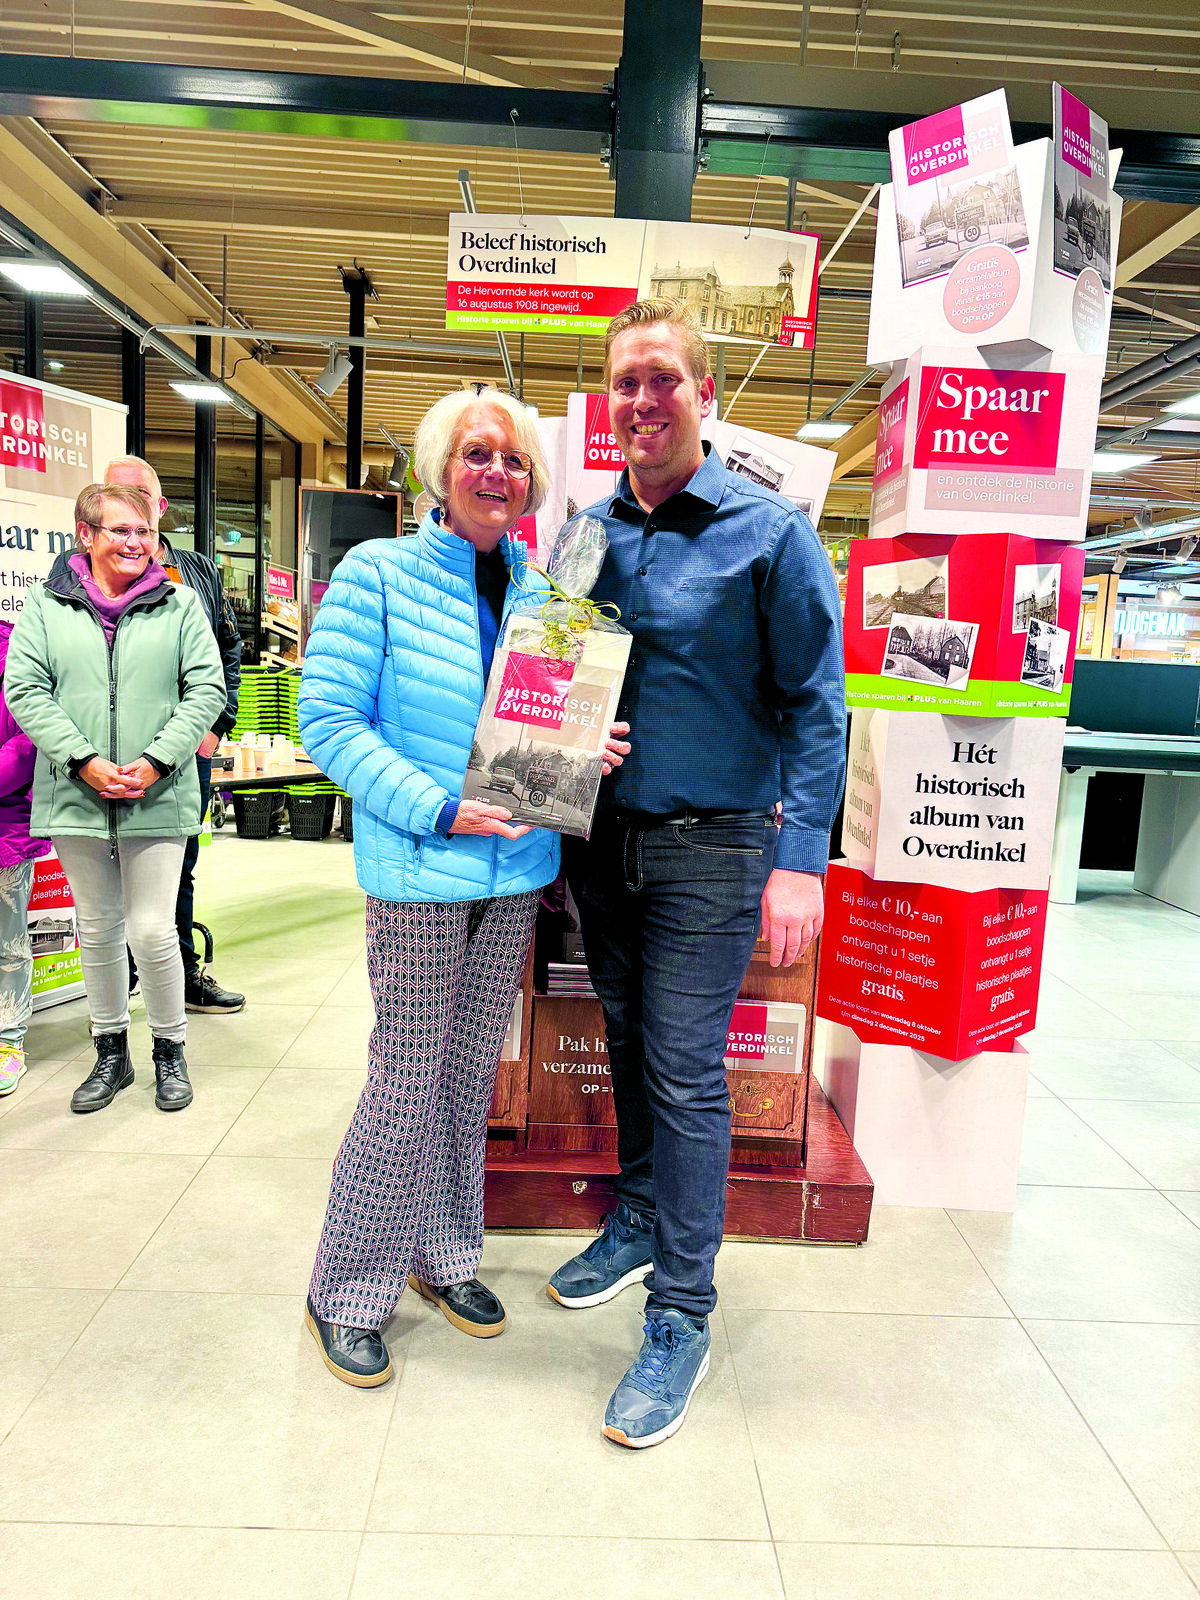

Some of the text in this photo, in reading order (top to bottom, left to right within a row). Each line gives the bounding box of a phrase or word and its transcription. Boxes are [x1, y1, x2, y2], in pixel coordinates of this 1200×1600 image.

[910, 123, 999, 164] HISTORISCH
[1064, 126, 1105, 164] HISTORISCH
[910, 137, 1000, 176] OVERDINKEL
[1064, 141, 1105, 178] OVERDINKEL
[460, 231, 606, 254] Beleef historisch
[458, 254, 556, 275] Overdinkel
[967, 258, 999, 273] Gratis
[953, 269, 1010, 286] verzamelalbum
[970, 281, 1002, 294] aankoop
[458, 285, 594, 301] De Hervormde kerk wordt op
[954, 290, 1006, 306] vanaf €15 aan
[457, 299, 582, 314] 16 augustus 1908 ingewijd.
[952, 299, 1007, 317] boodschappen
[962, 315, 974, 325] OP
[982, 311, 994, 321] OP
[456, 315, 490, 324] Historie
[491, 317, 520, 327] sparen
[521, 317, 532, 327] bij
[936, 373, 1049, 420] Spaar
[880, 396, 905, 442] Spaar
[0, 434, 88, 468] RDINKEL
[931, 428, 1009, 455] mee
[876, 445, 894, 476] mee
[937, 475, 1074, 491] en ontdek de historie
[936, 488, 1036, 504] van Overdinkel.
[503, 686, 602, 714] HISTORISCH
[872, 693, 895, 701] sparen
[896, 693, 907, 702] bij
[914, 695, 936, 703] PLUS
[954, 698, 982, 706] Haaren
[500, 701, 598, 729] OVERDINKEL
[952, 741, 998, 764] Hét
[852, 759, 874, 786] historisch
[915, 773, 1025, 798] historisch
[909, 805, 1024, 830] album van
[846, 814, 871, 849] Overdinkel
[902, 836, 1026, 863] Overdinkel
[33, 888, 62, 902] plaatjes
[842, 891, 943, 925] Bij elke € 10,- aan
[982, 916, 992, 928] Bij
[992, 913, 1005, 924] elke
[1007, 905, 1013, 921] €
[1027, 905, 1037, 915] aan
[849, 914, 930, 943] boodschappen
[986, 926, 1031, 947] boodschappen
[842, 934, 935, 967] ontvangt u 1 setje
[980, 945, 1032, 970] ontvangt u 1 setje
[34, 966, 46, 978] bij
[836, 951, 939, 990] historische plaatjes
[976, 965, 1032, 992] historische plaatjes
[828, 995, 841, 1005] Deze
[856, 1004, 870, 1013] loopt
[881, 1012, 911, 1027] woensdag
[916, 1023, 942, 1035] oktober
[841, 1010, 851, 1018] t/m
[851, 1014, 874, 1026] dinsdag
[879, 1023, 908, 1036] december
[909, 1032, 925, 1042] 2025
[558, 1035, 591, 1052] Pak
[582, 1084, 600, 1094] OP
